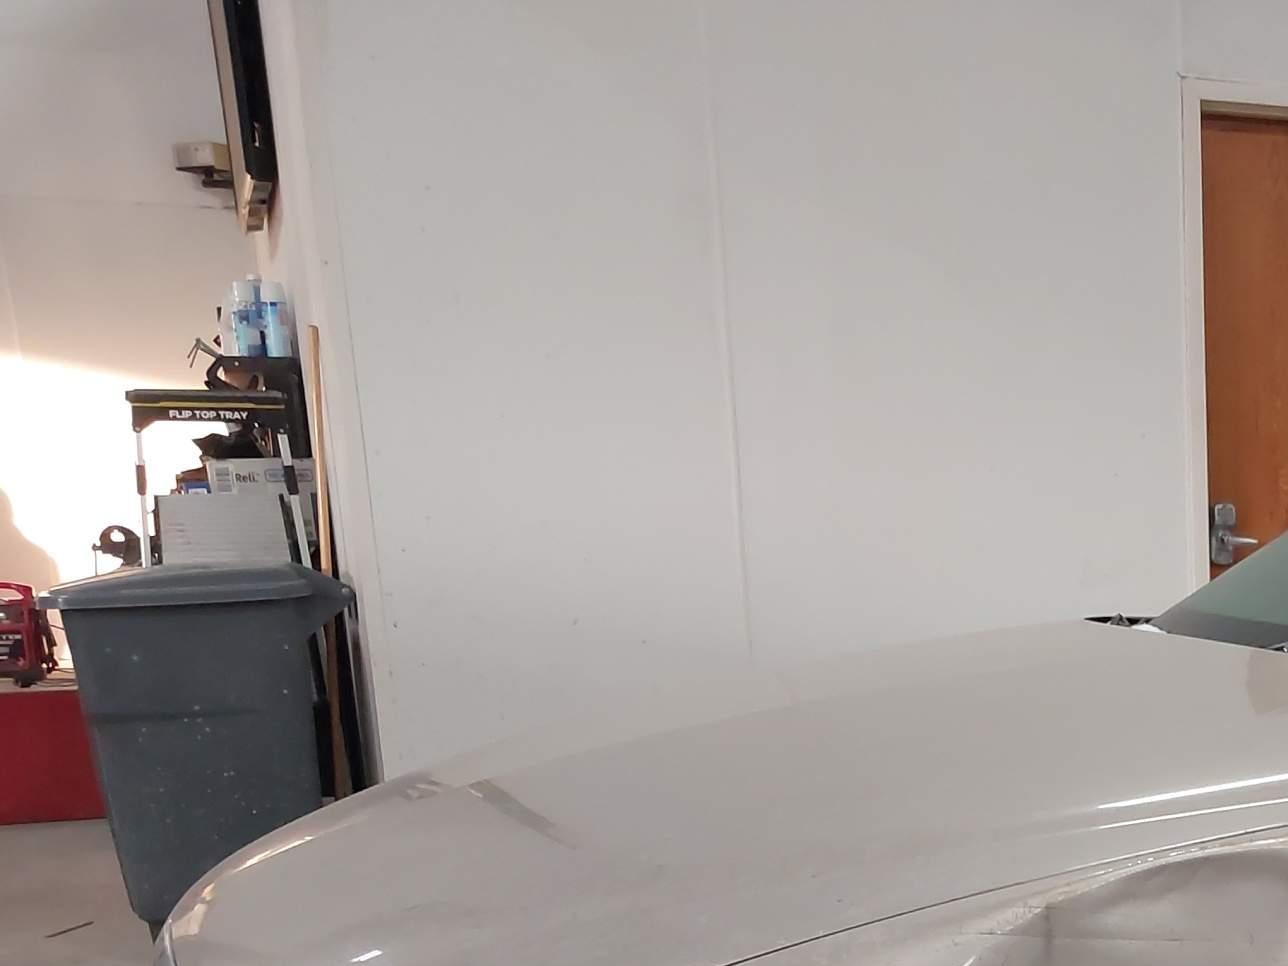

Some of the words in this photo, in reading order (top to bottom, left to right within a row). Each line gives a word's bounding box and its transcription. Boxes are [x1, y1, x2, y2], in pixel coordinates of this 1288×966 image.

[168, 409, 193, 419] FLIP
[195, 410, 217, 419] TOP
[218, 410, 249, 420] TRAY
